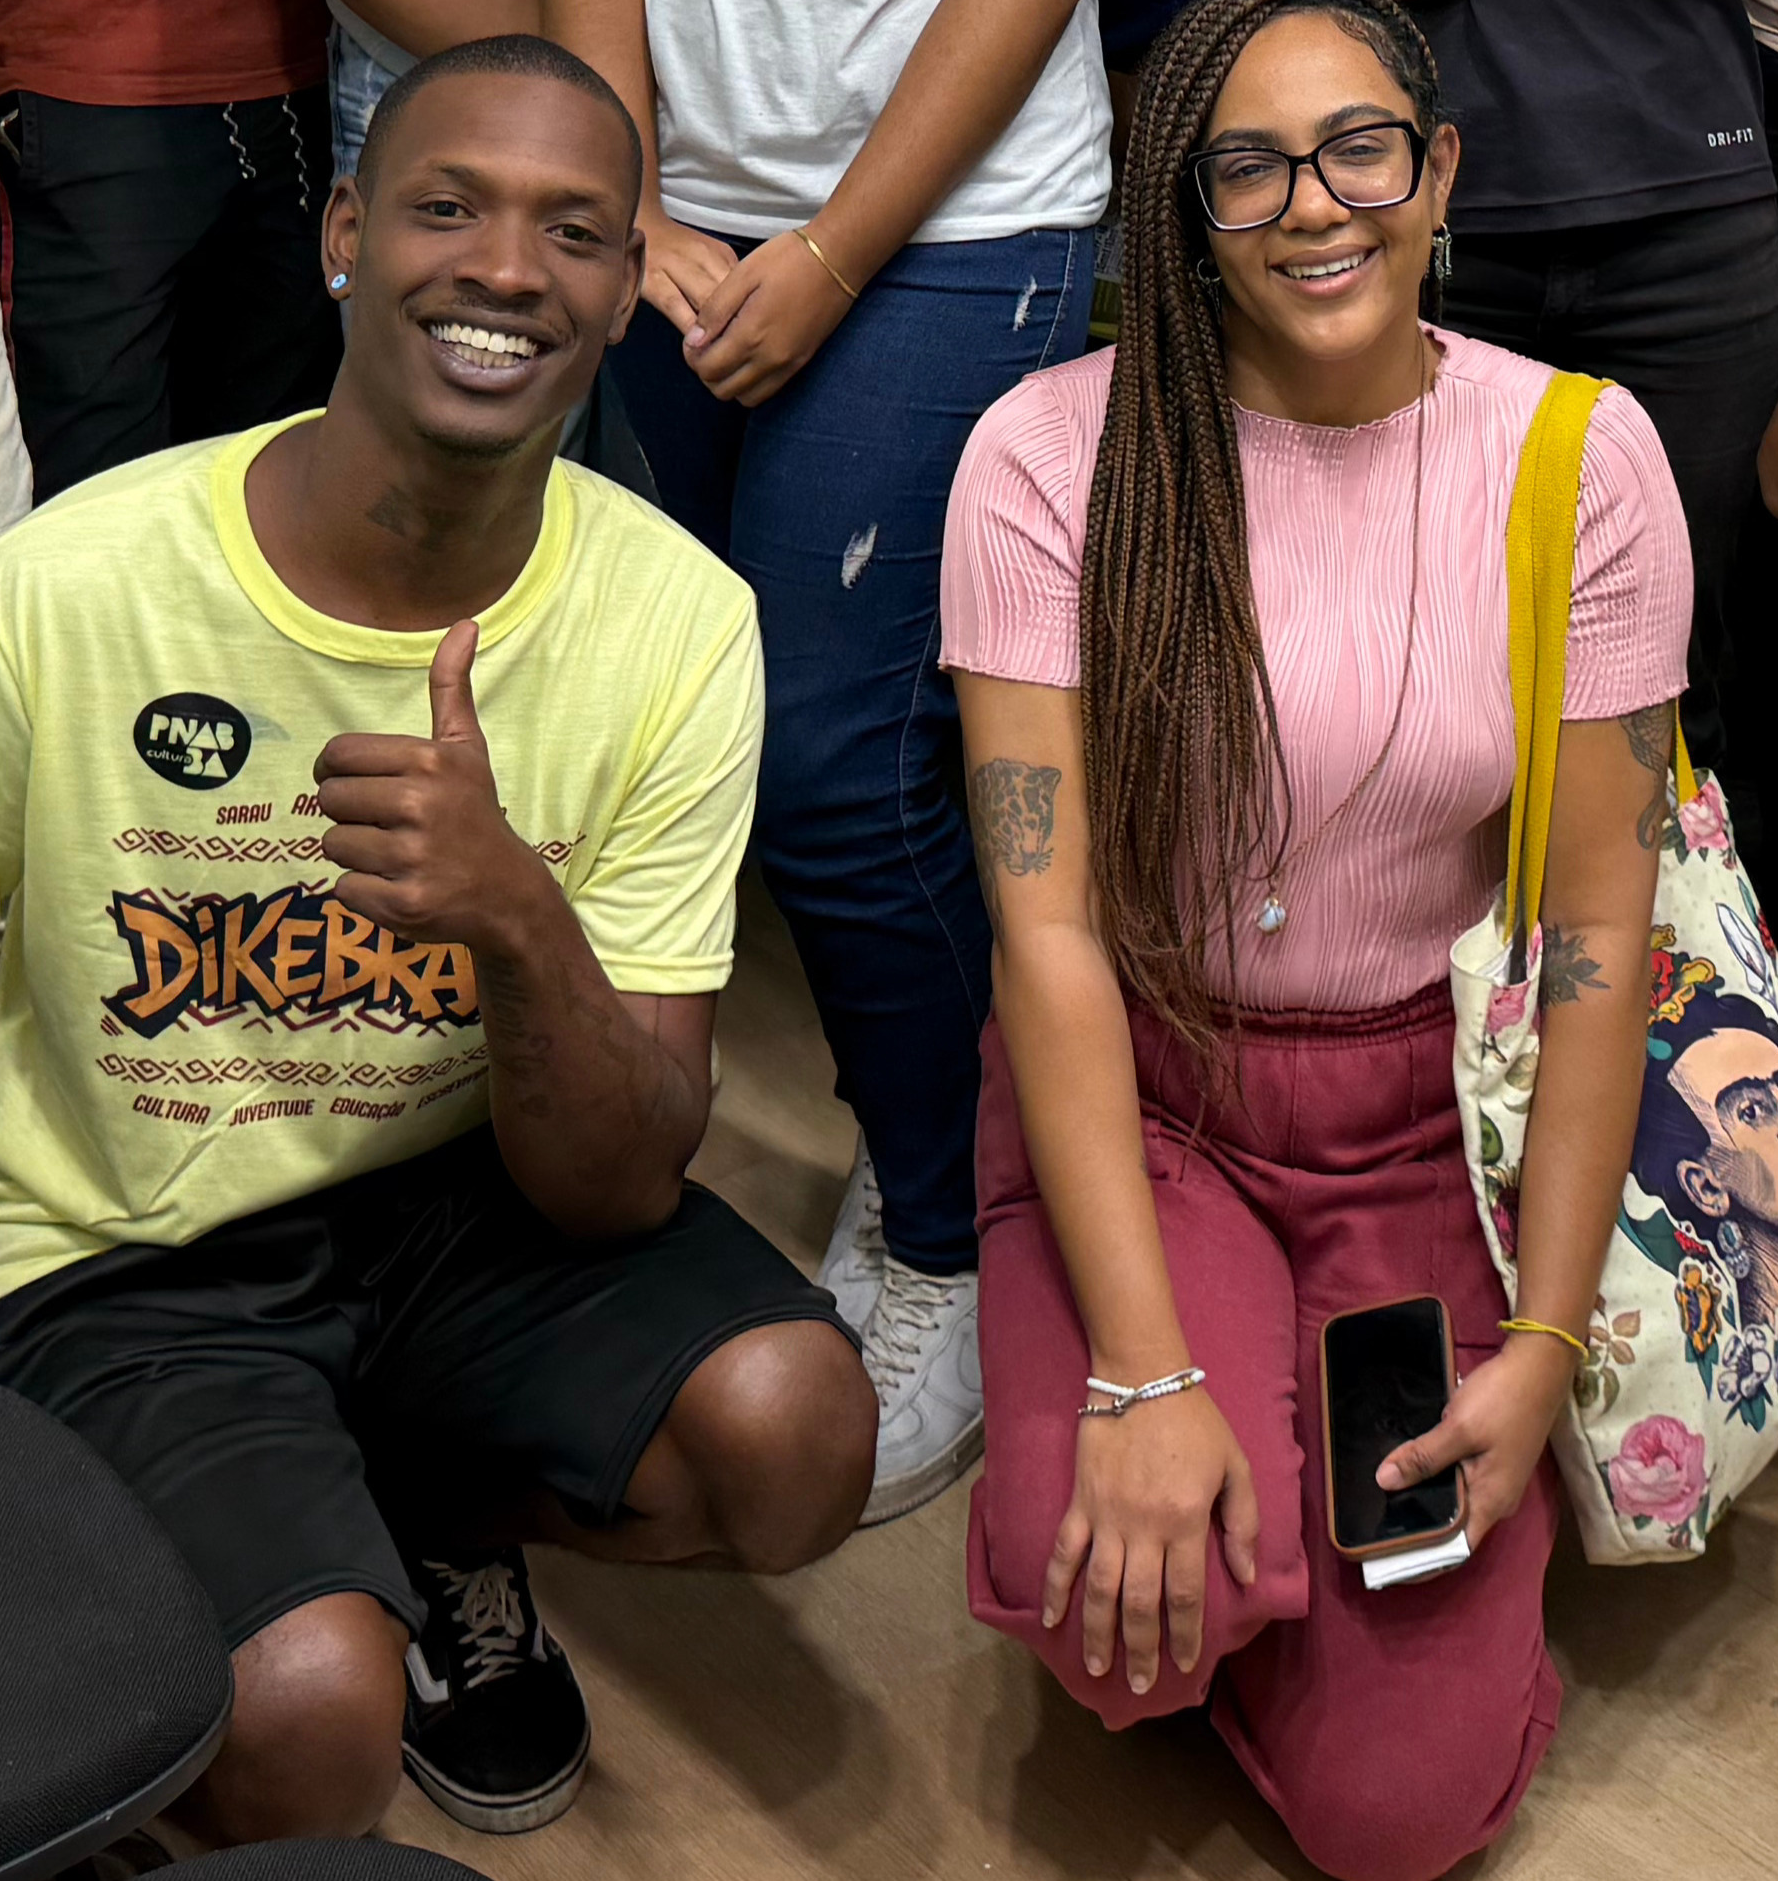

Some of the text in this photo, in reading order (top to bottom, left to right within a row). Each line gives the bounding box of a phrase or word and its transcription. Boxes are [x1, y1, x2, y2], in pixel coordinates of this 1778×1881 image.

[1707, 128, 1754, 148] DRI-FIT
[149, 712, 234, 751] PNAB
[216, 803, 272, 825] SARAU
[133, 1094, 405, 1127] CULTURA JUVENTUDE EDUCAÇÃO
